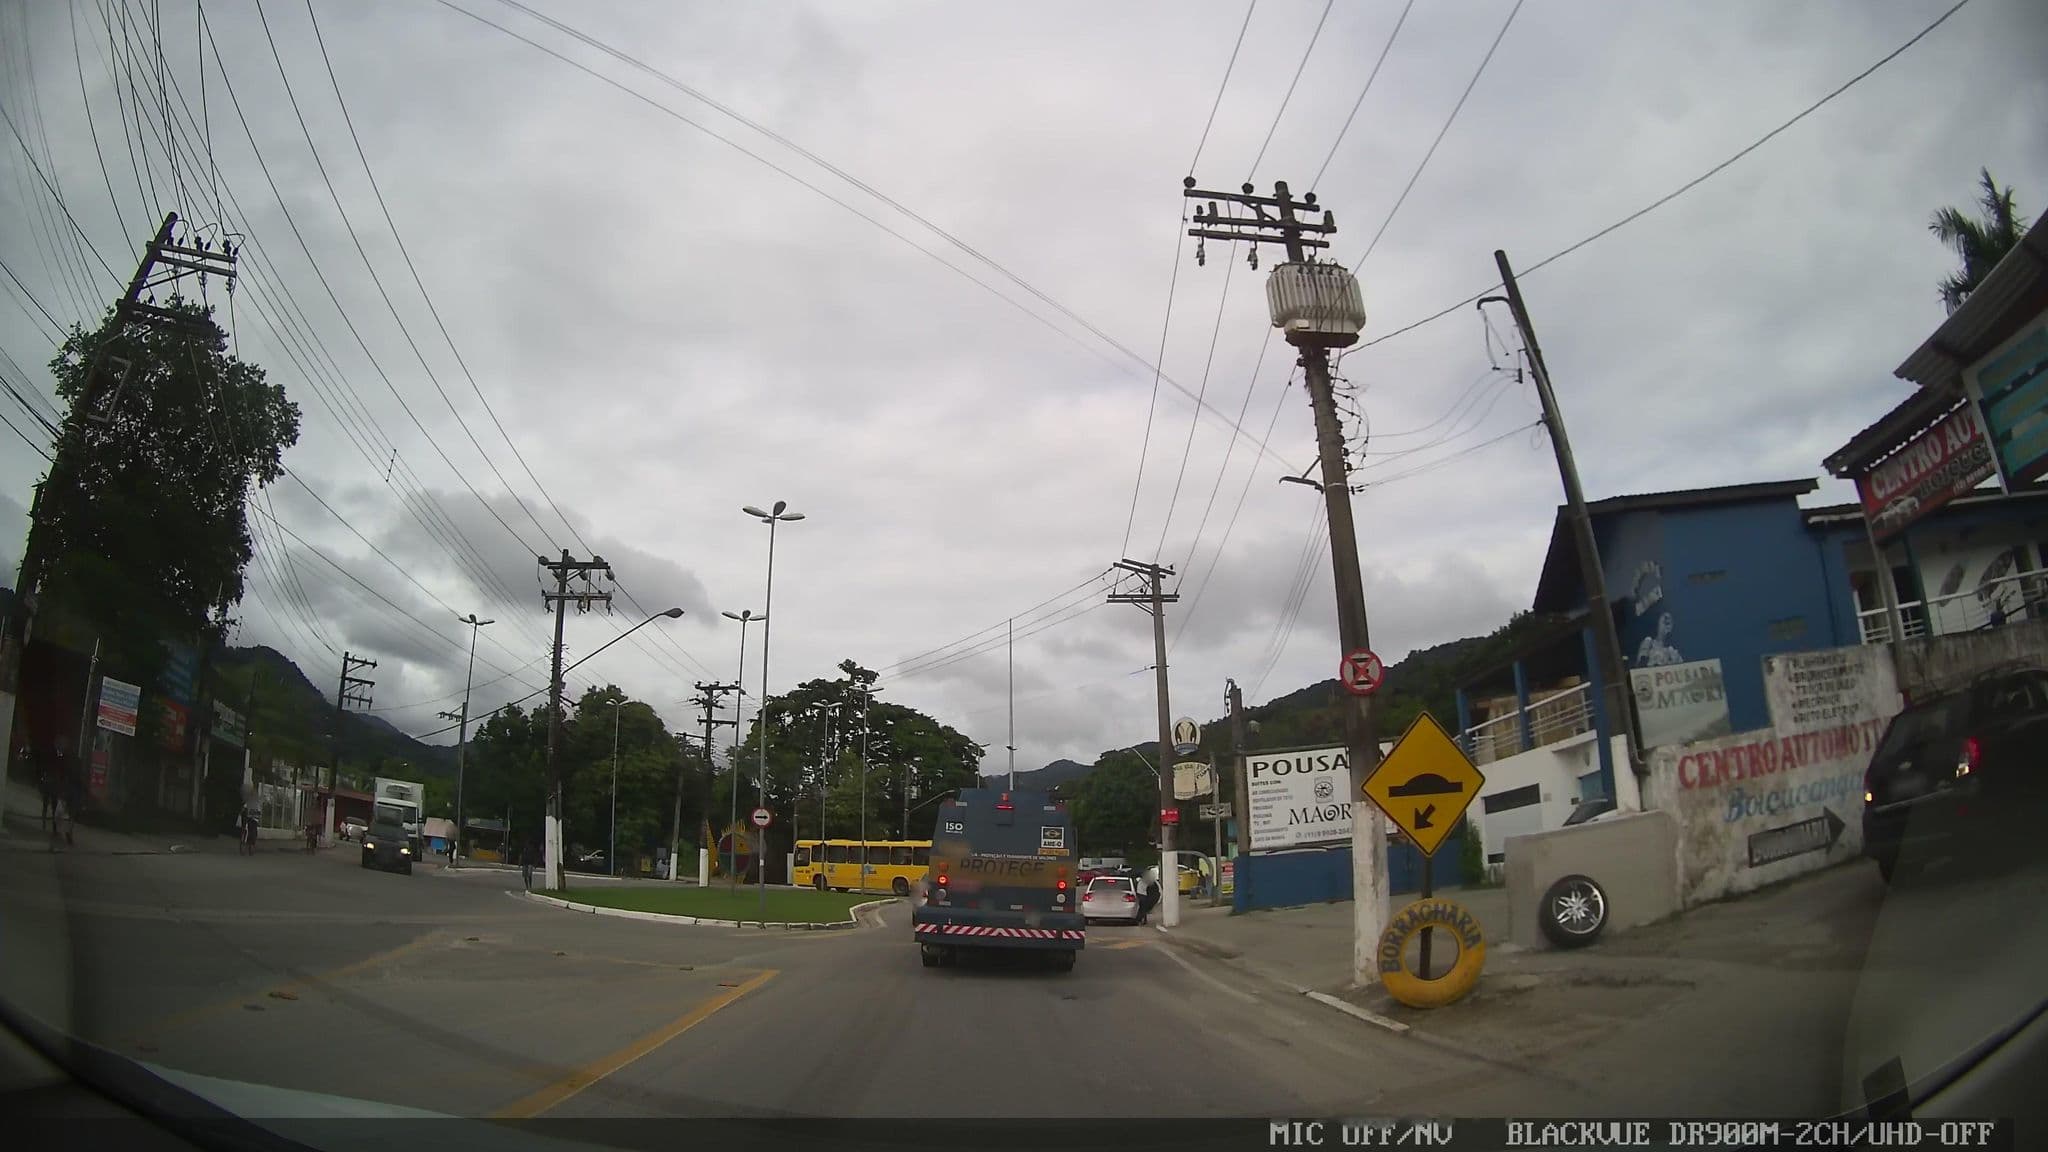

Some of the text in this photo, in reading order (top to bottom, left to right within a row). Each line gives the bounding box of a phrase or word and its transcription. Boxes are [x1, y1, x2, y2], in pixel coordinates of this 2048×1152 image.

[1871, 431, 1943, 500] CENTRO
[1679, 741, 1778, 789] CENTRO
[945, 822, 963, 830] ISO
